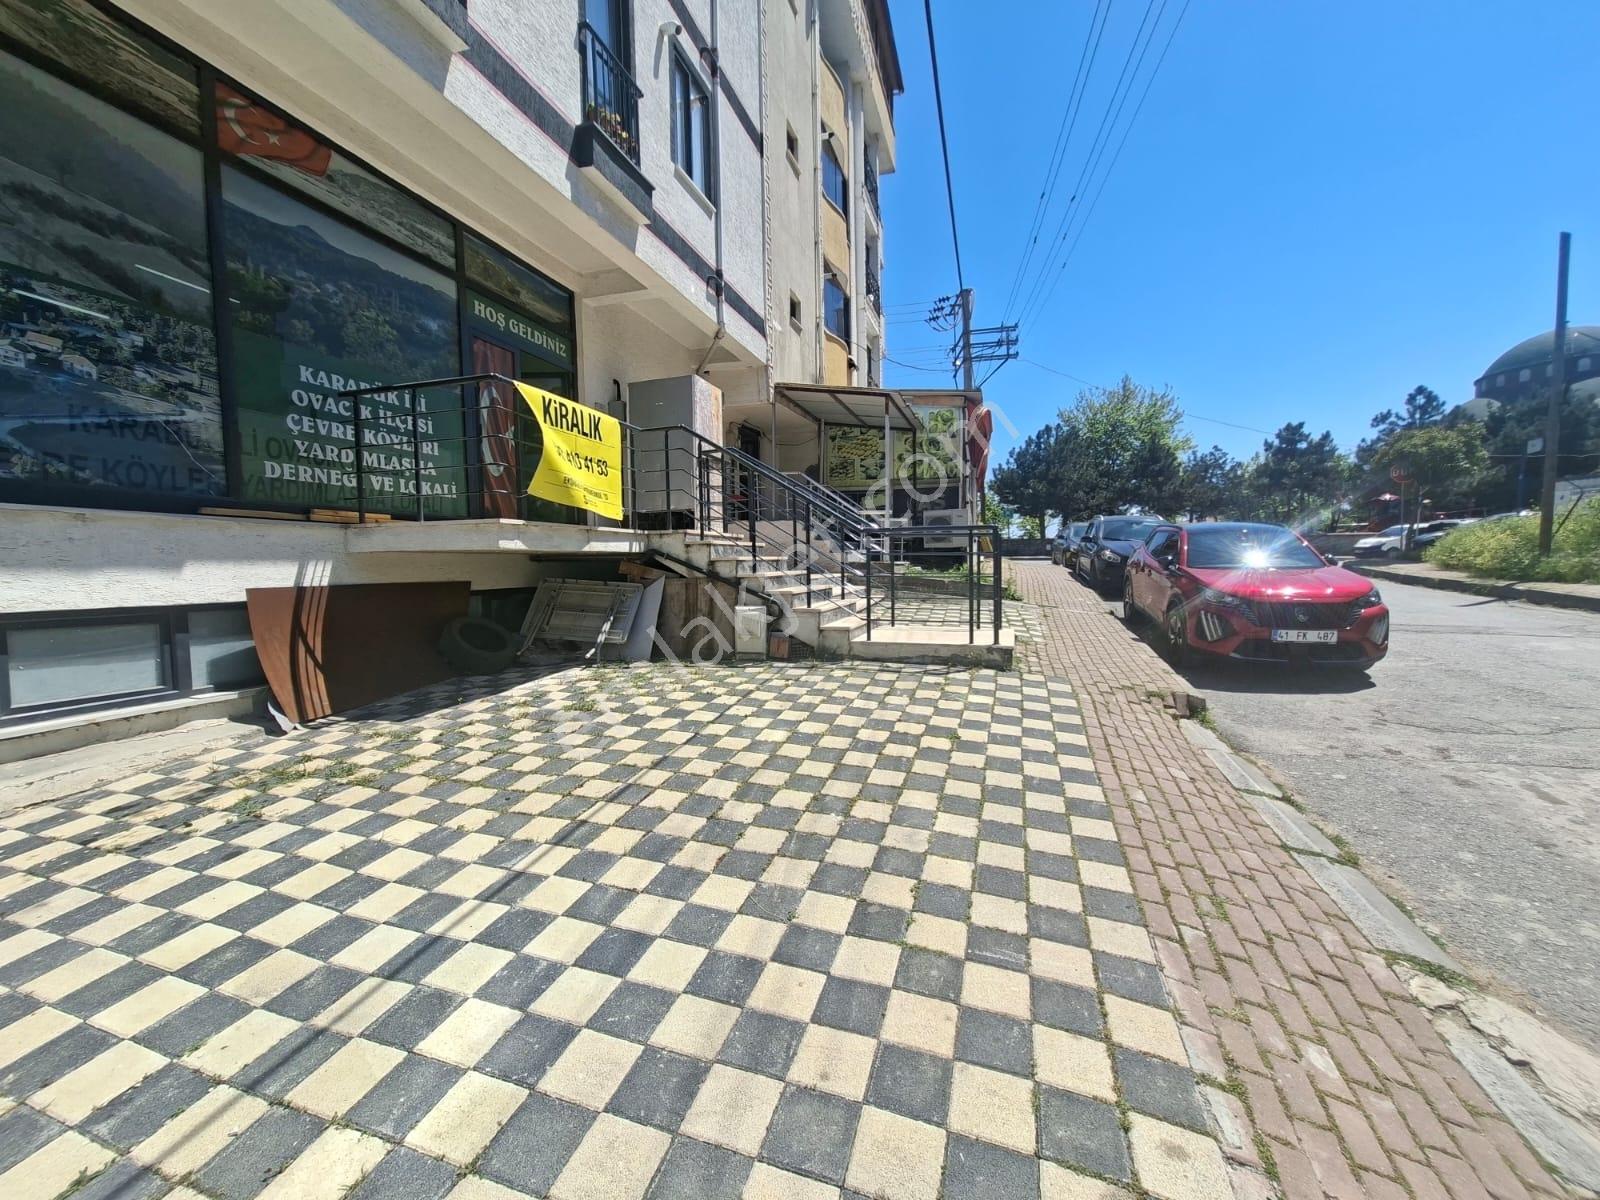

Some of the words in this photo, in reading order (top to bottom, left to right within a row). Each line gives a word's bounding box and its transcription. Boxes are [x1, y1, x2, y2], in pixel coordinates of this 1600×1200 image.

[473, 300, 505, 332] HOŞ
[509, 319, 567, 357] GELDİNİZ
[291, 389, 373, 422] OVACK
[286, 413, 356, 441] ÇEVRE
[264, 461, 366, 488] DERNEĞ
[369, 474, 394, 493] VE
[1278, 631, 1289, 640] 41
[1296, 631, 1308, 640] FK
[1317, 631, 1335, 641] 487
